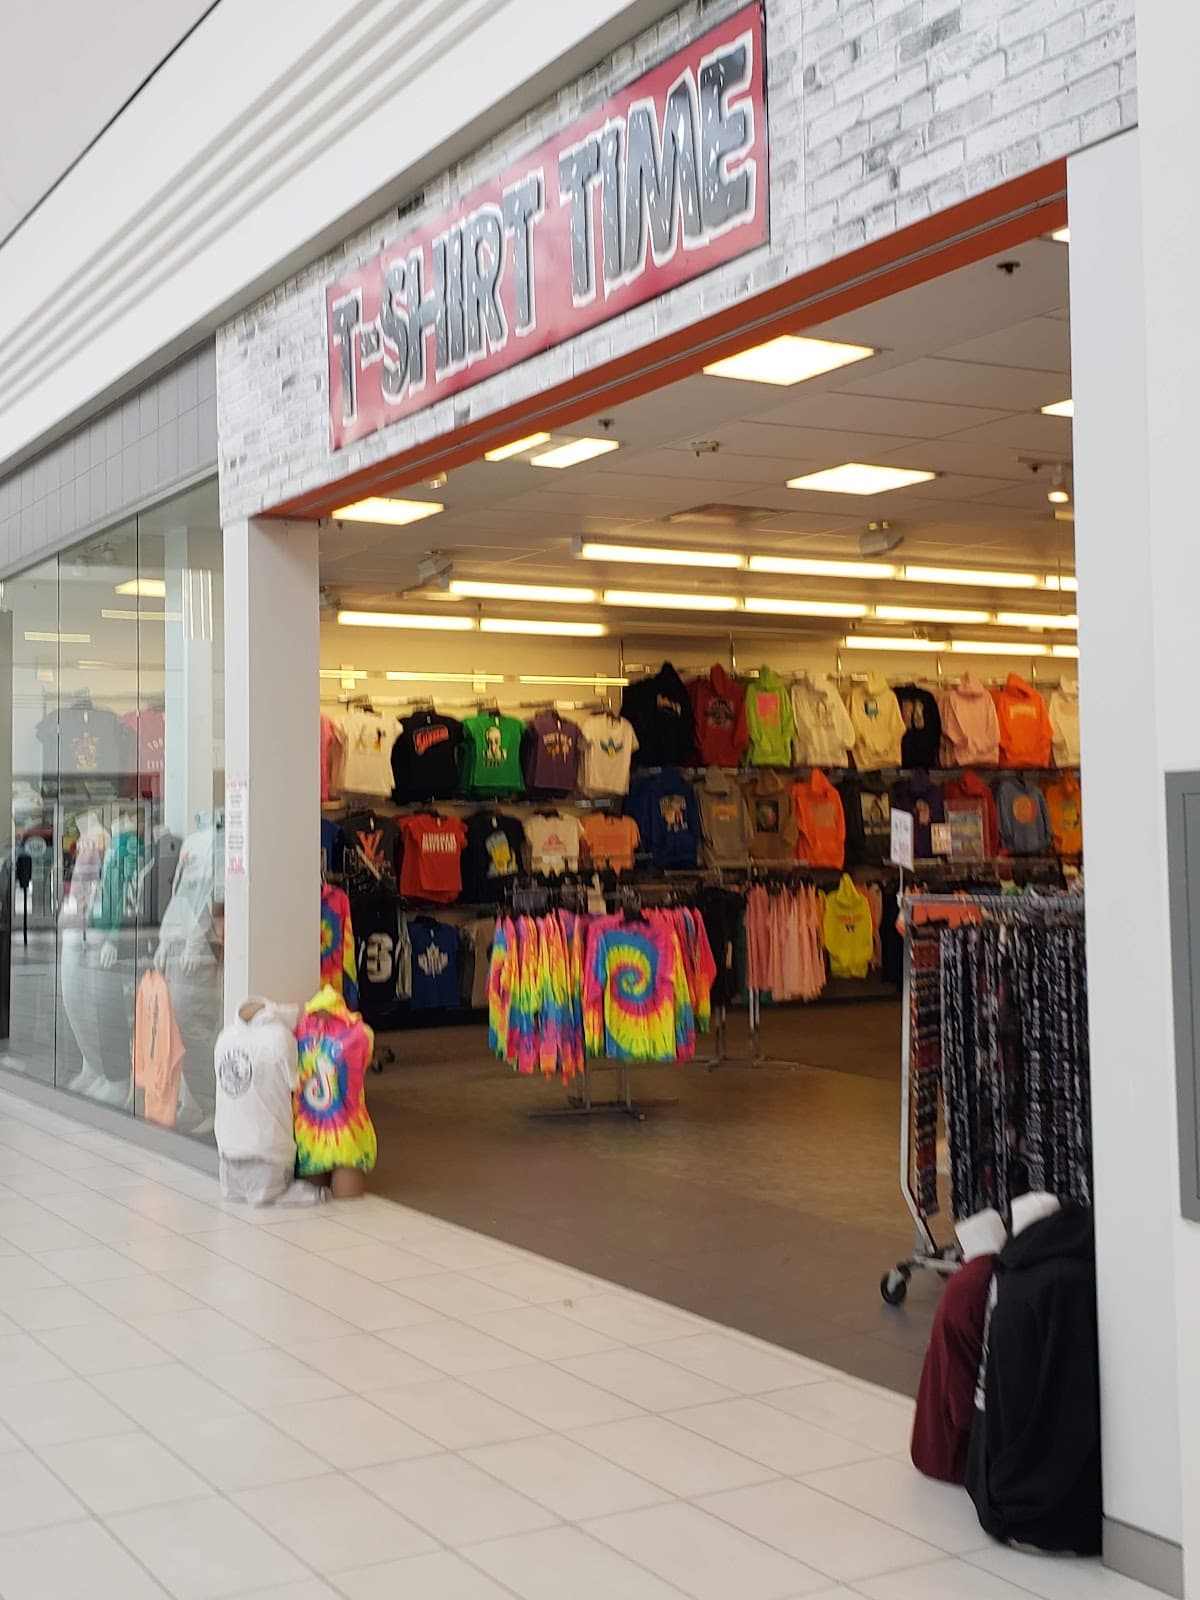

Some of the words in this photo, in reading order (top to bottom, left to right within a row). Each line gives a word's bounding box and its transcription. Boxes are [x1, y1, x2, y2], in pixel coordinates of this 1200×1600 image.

[331, 168, 544, 426] T-SHIRT
[559, 30, 756, 307] TIME
[366, 932, 393, 983] 3
